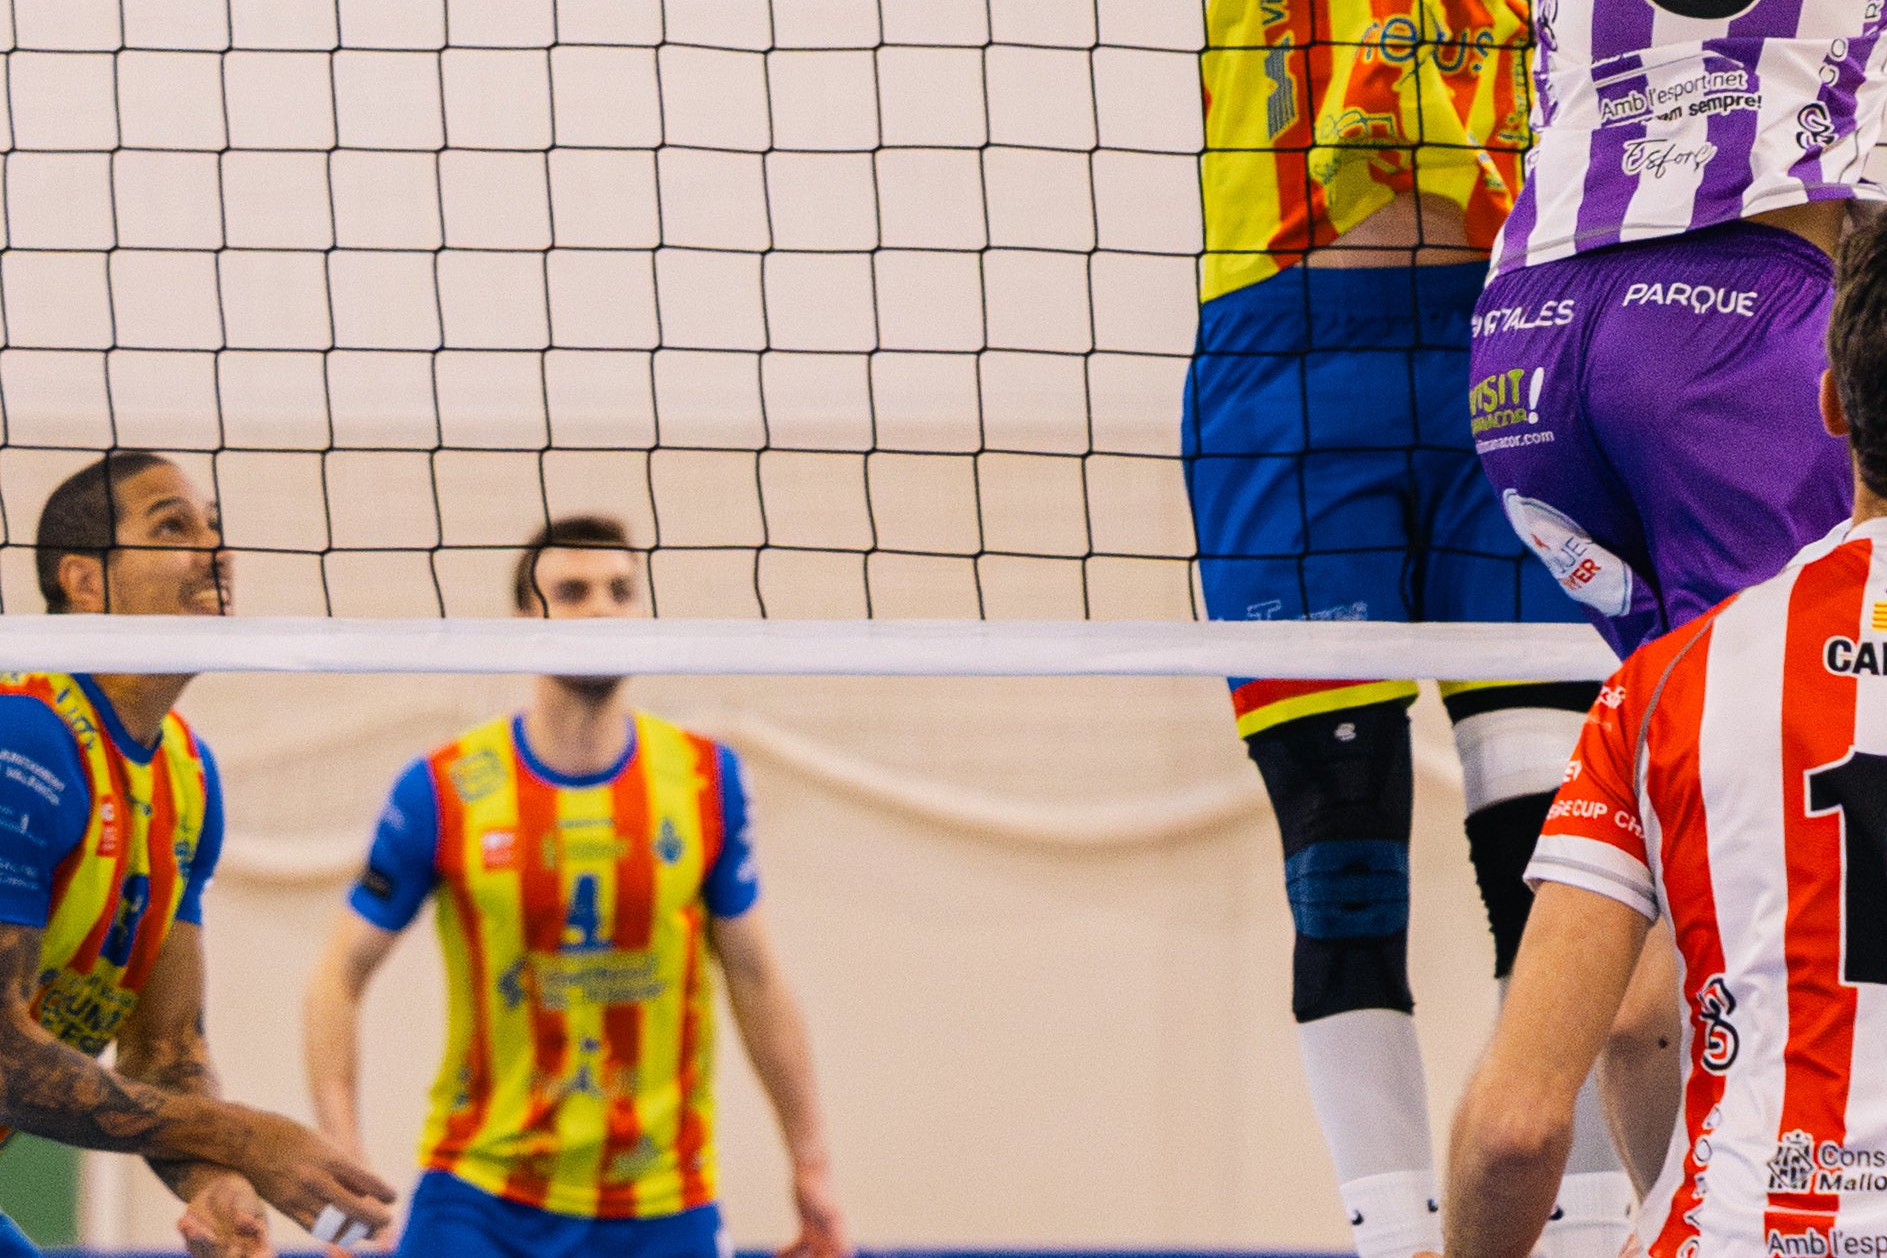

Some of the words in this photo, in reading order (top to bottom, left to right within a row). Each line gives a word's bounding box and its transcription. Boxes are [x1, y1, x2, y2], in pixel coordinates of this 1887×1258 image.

[1602, 95, 1645, 119] Amb
[1649, 75, 1711, 107] l'esport
[1713, 75, 1744, 88] net
[1688, 95, 1762, 117] sempre!
[1622, 282, 1759, 317] PARQUE
[1769, 1232, 1826, 1255] Amb
